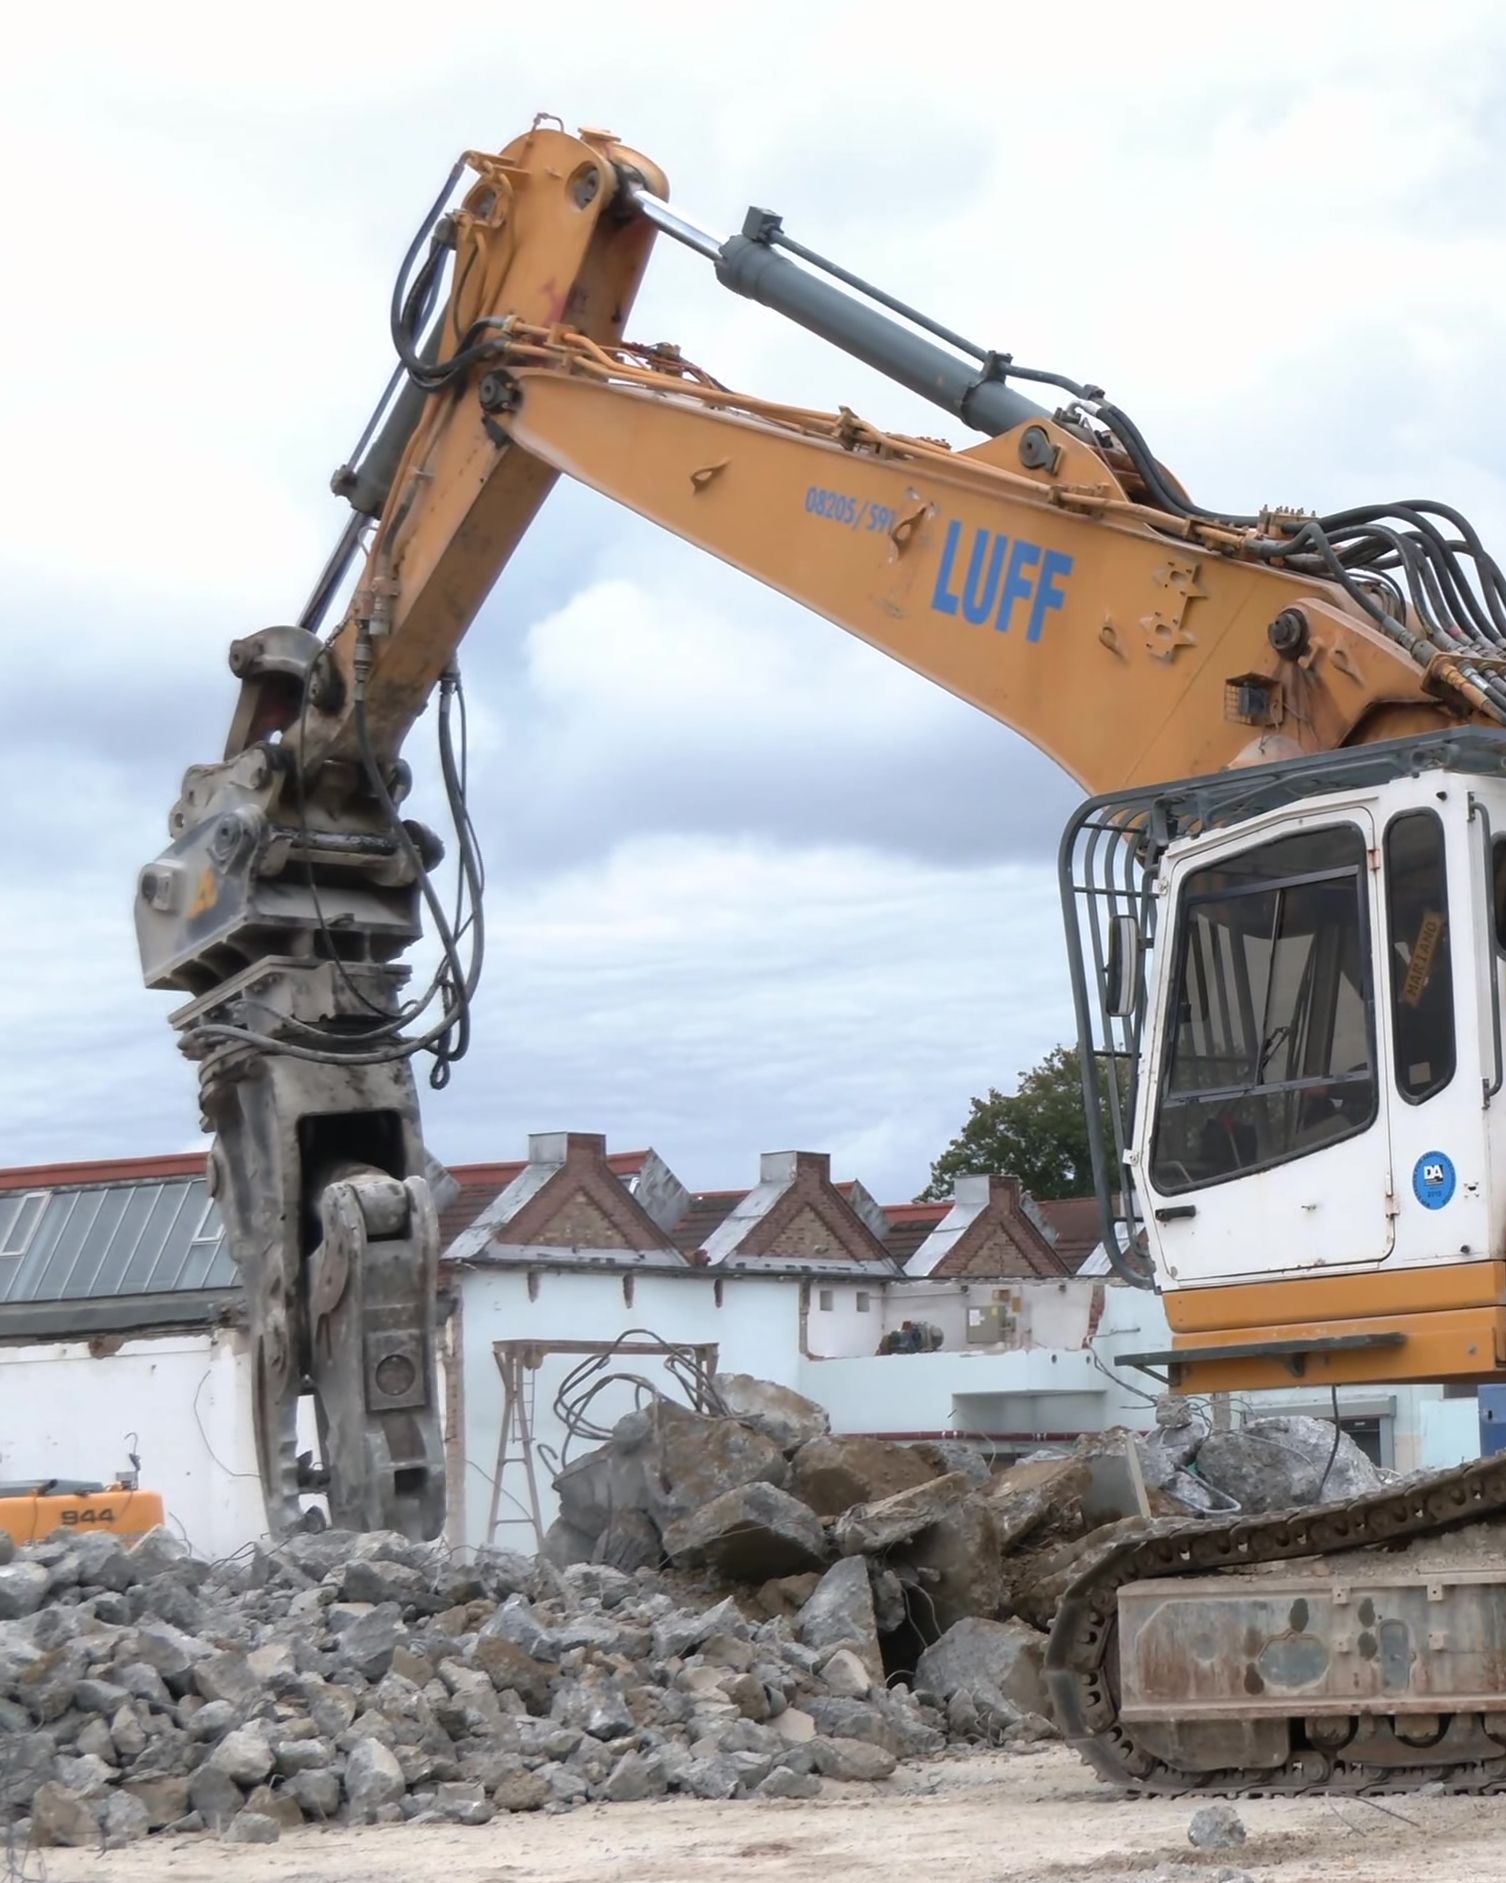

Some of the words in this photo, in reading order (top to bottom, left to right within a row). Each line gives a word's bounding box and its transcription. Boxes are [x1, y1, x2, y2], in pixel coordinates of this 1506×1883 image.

[931, 519, 1074, 643] LUFF
[1407, 921, 1437, 997] MARIANO
[1423, 1164, 1443, 1180] DA
[61, 1508, 115, 1525] 944
